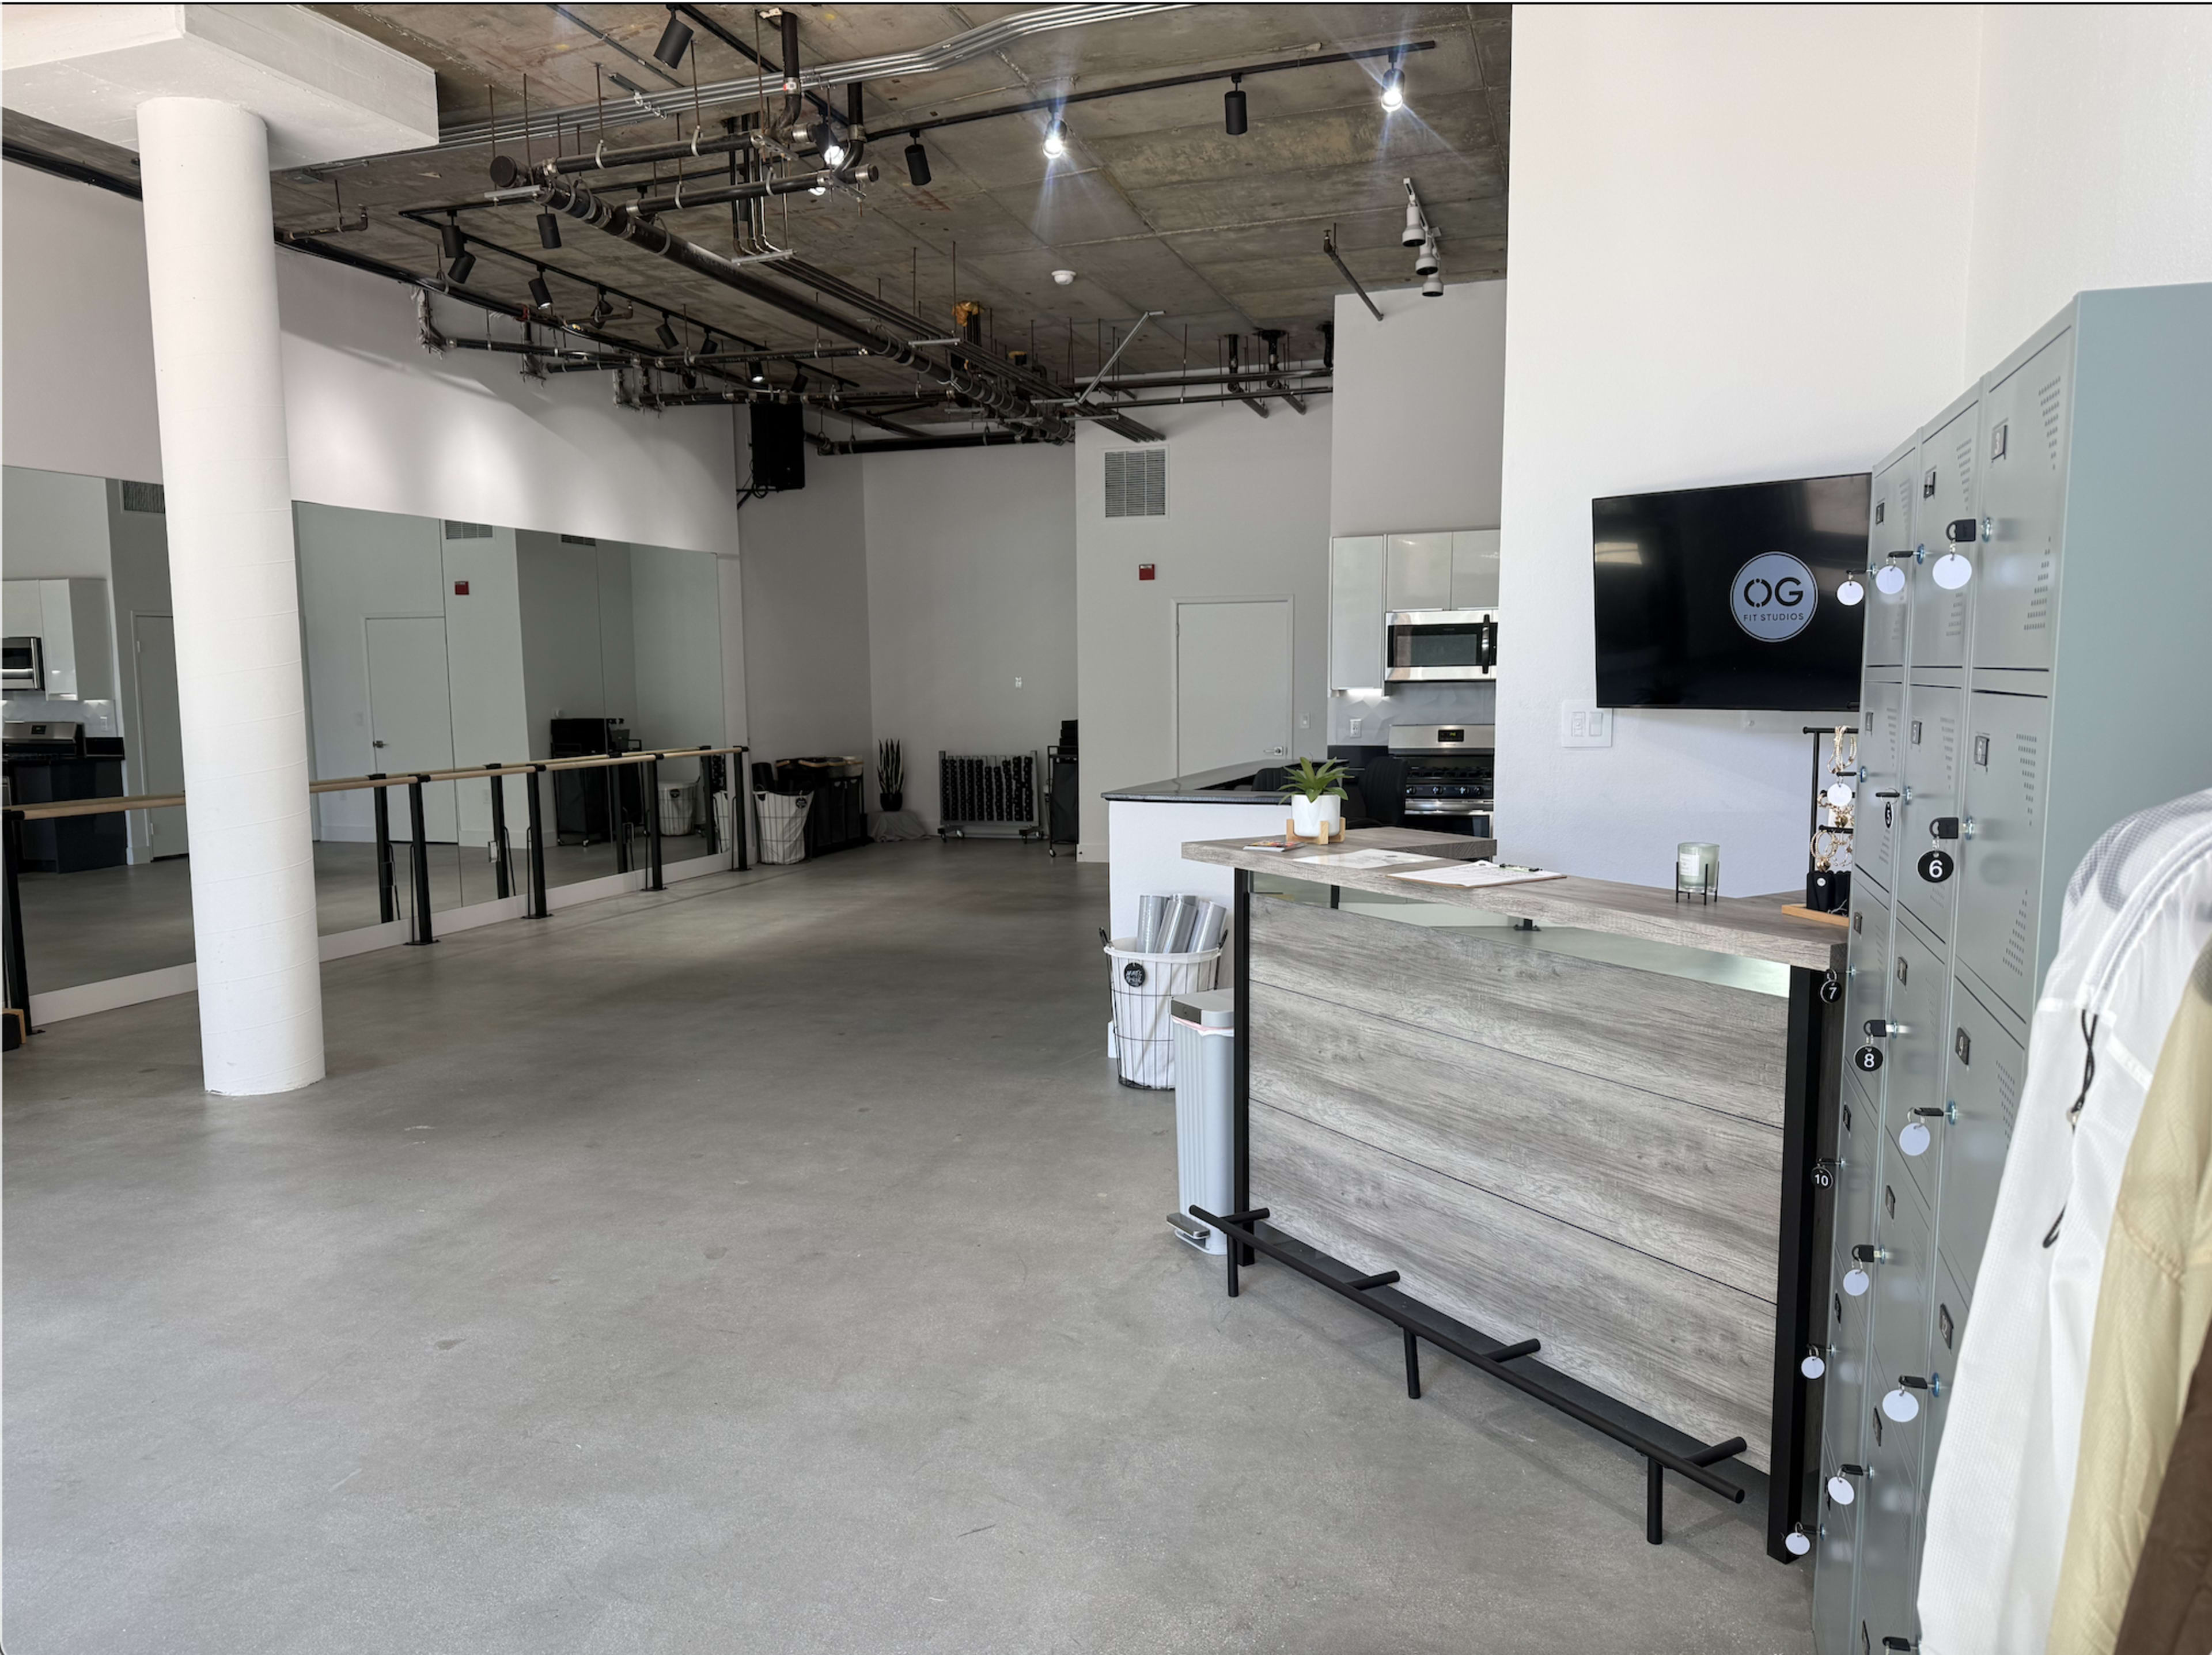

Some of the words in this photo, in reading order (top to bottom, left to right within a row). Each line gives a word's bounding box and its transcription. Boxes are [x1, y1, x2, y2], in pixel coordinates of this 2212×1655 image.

[1744, 577, 1804, 608] OG
[1760, 612, 1804, 622] STUDIOS
[1929, 859, 1942, 878] 6
[1829, 987, 1837, 999] 7
[1863, 1053, 1875, 1068] 8
[1815, 1174, 1828, 1187] 10
